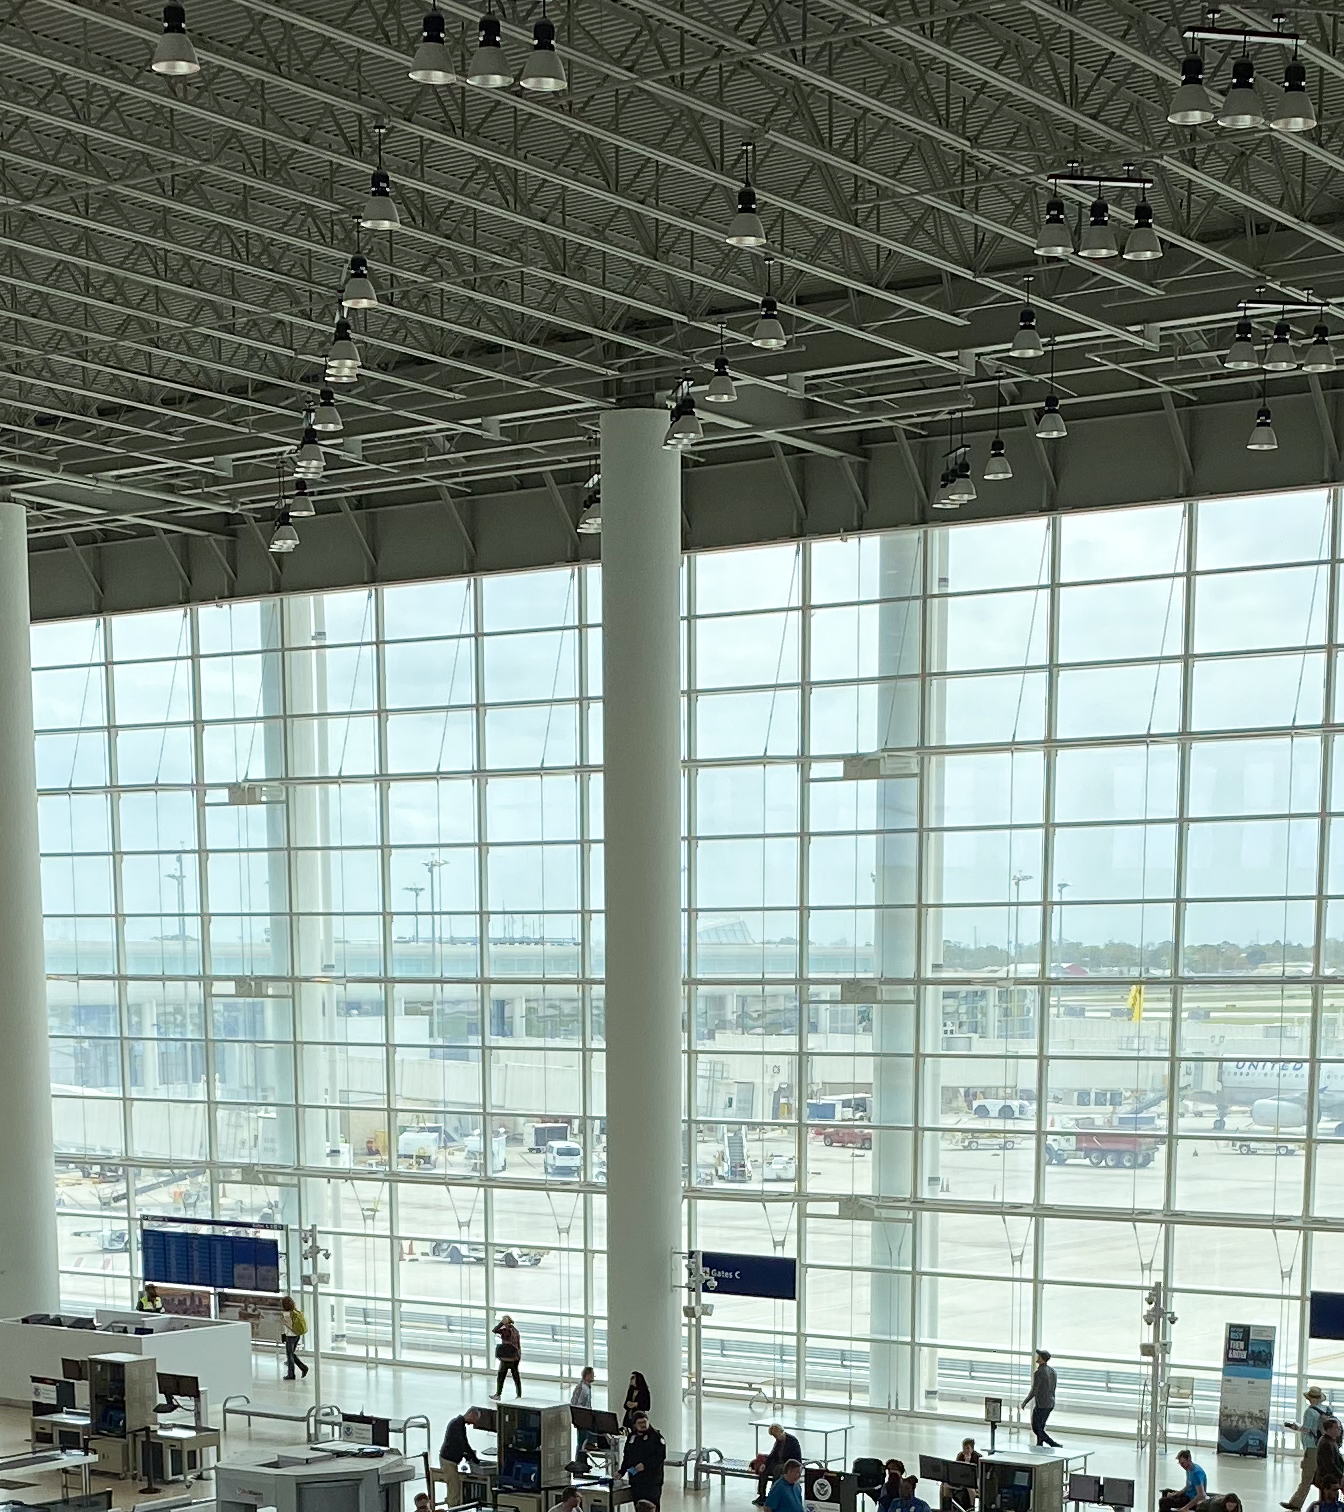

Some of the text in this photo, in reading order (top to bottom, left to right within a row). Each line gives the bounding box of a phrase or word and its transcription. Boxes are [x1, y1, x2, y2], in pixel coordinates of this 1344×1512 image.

[1235, 1061, 1304, 1071] UNITED
[711, 1268, 741, 1279] Gates C
